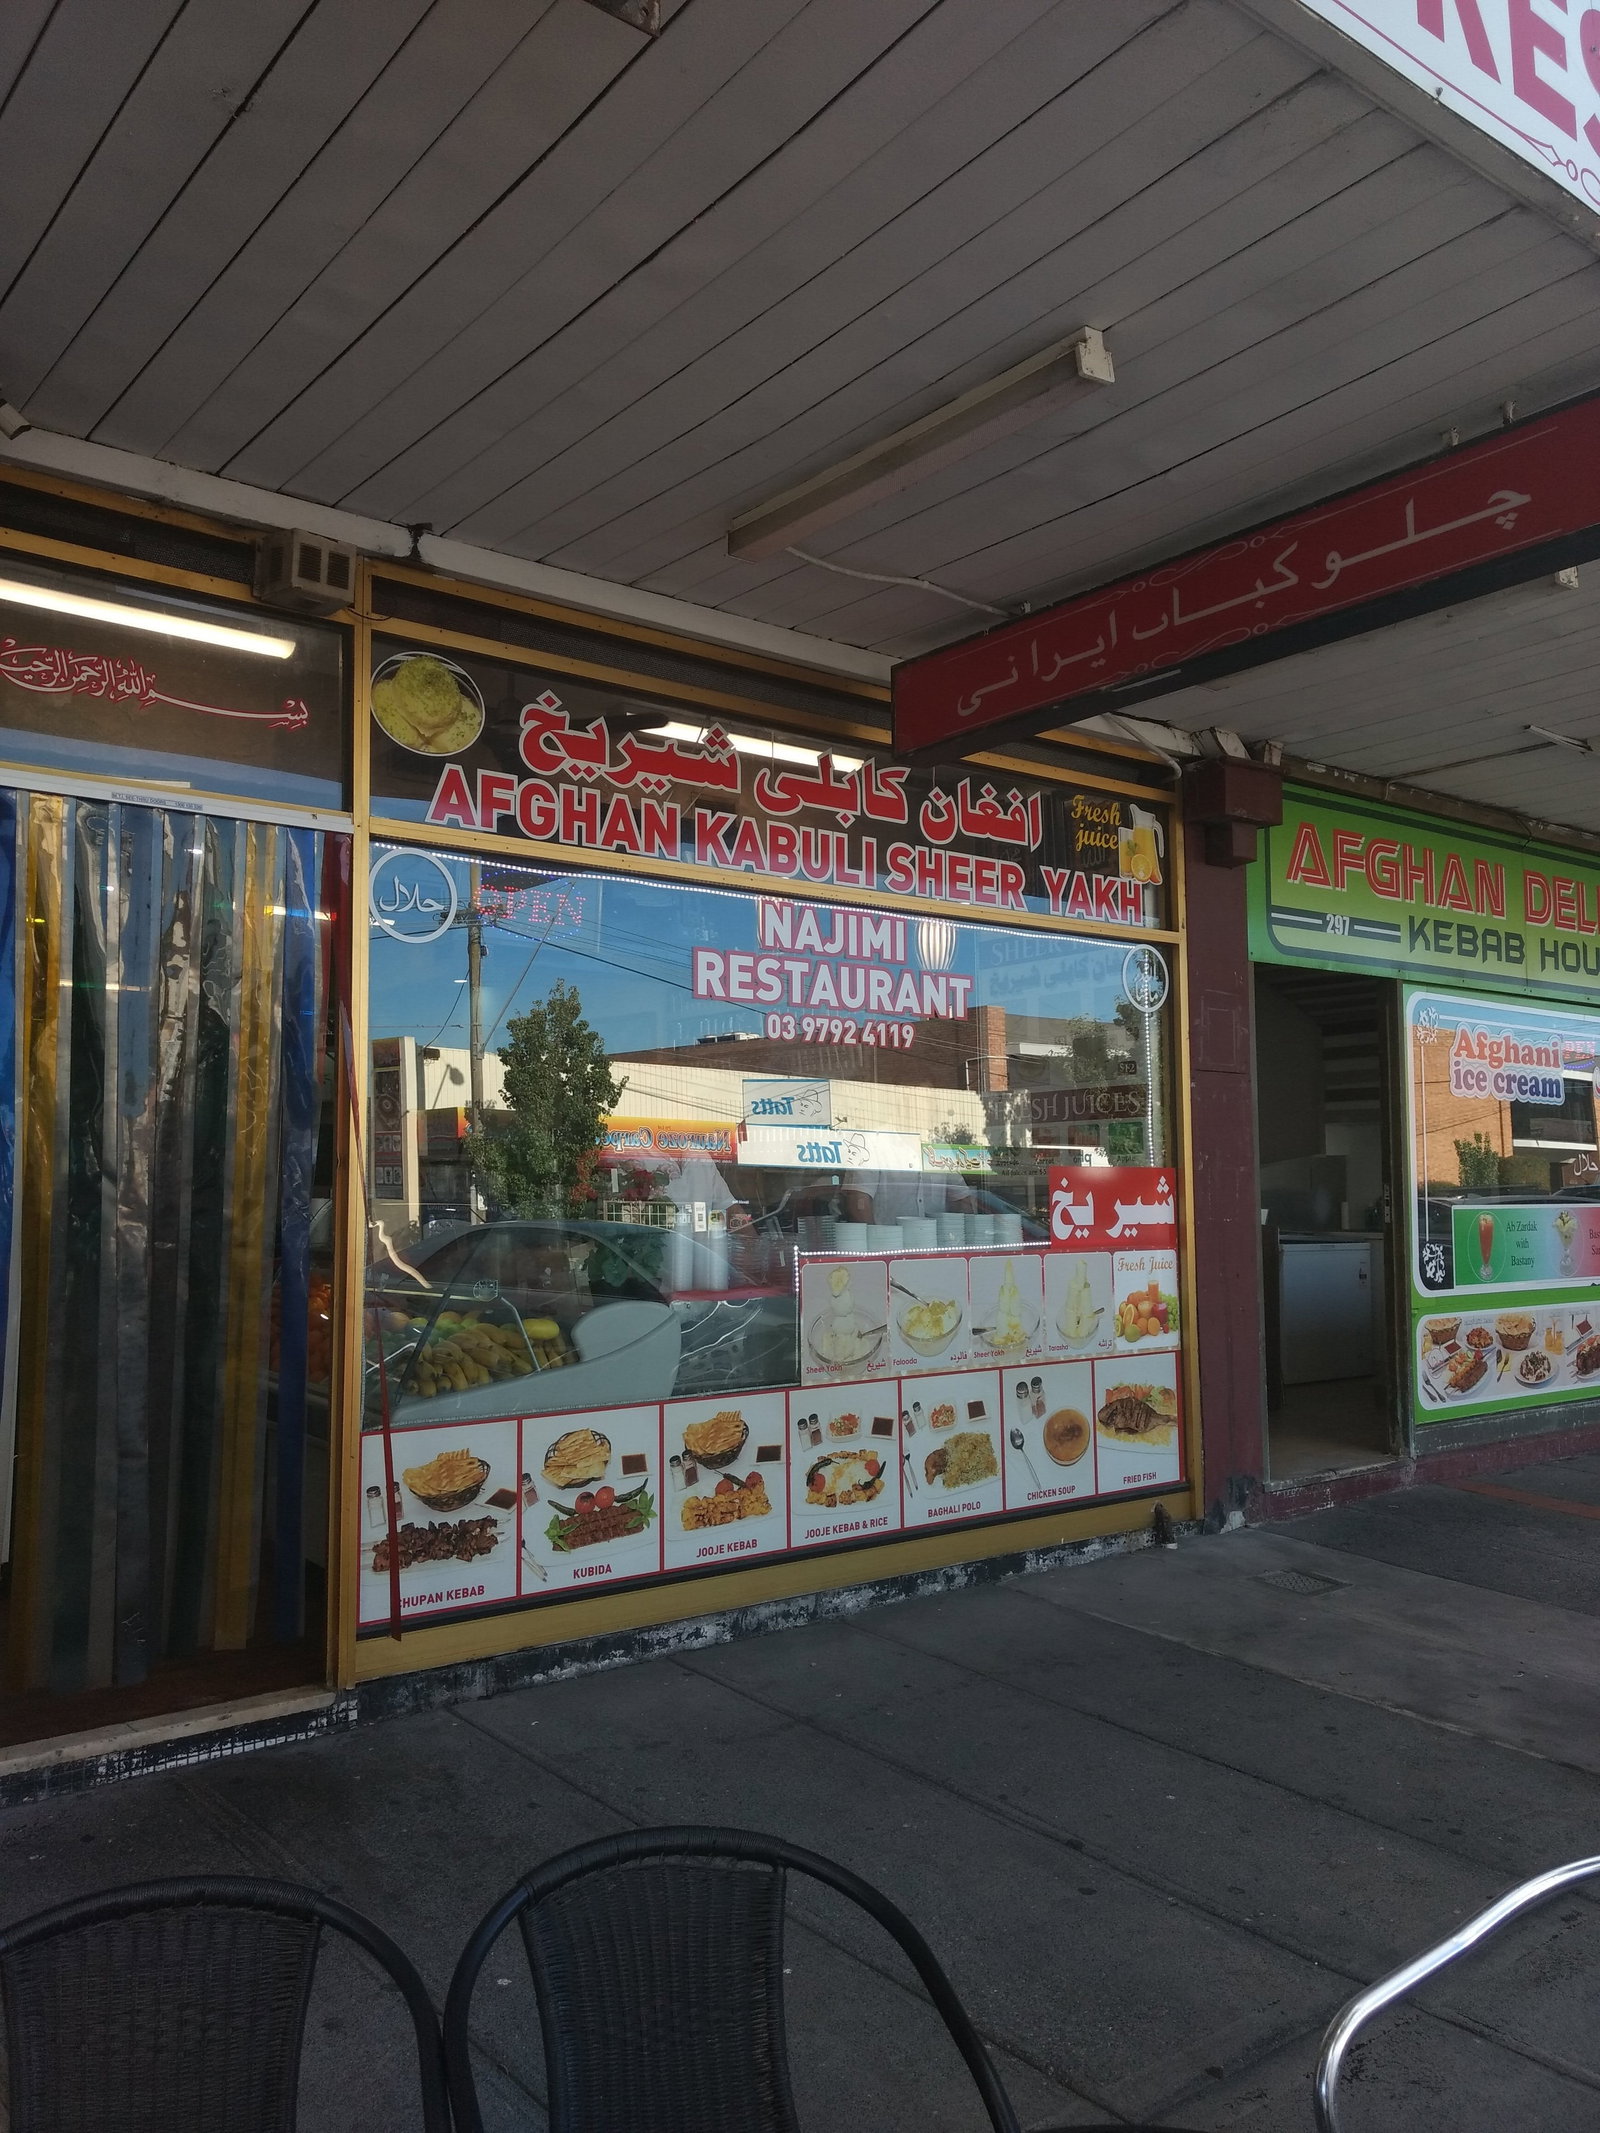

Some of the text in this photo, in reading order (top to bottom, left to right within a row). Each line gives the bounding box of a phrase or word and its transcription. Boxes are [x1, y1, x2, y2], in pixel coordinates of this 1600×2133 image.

[919, 777, 1043, 852] افغان
[1071, 795, 1121, 826] Fresh
[425, 763, 1145, 927] AFGHAN KABULI SHEER YAKH
[1075, 823, 1119, 852] juice
[1286, 821, 1507, 920] AFGHAN
[379, 875, 447, 913] حلال
[473, 884, 586, 926] OPEN
[760, 900, 907, 965] NAJIMI
[1325, 914, 1350, 936] 297
[1408, 915, 1525, 965] KEBAB
[692, 947, 974, 1021] RESTAURANT
[766, 1012, 916, 1050] 03 9792 4119
[1453, 1028, 1560, 1069] Afghani
[1454, 1060, 1561, 1098] ice cream
[1063, 1089, 1140, 1121] JUICES
[1573, 1153, 1599, 1176] حلال
[1118, 1256, 1173, 1274] Fresh Juice
[893, 1358, 918, 1366] Falooda
[1027, 1485, 1076, 1501] CHICKEN SOUP
[1123, 1471, 1157, 1484] FRIED FISH
[928, 1500, 981, 1518] BAGHALI POLO
[805, 1516, 889, 1539] JOOJE KEBAB & RICE
[696, 1539, 758, 1558] JOOJE KEBAB
[573, 1563, 612, 1580] KUBIDA
[447, 1585, 485, 1600] KEBAB
